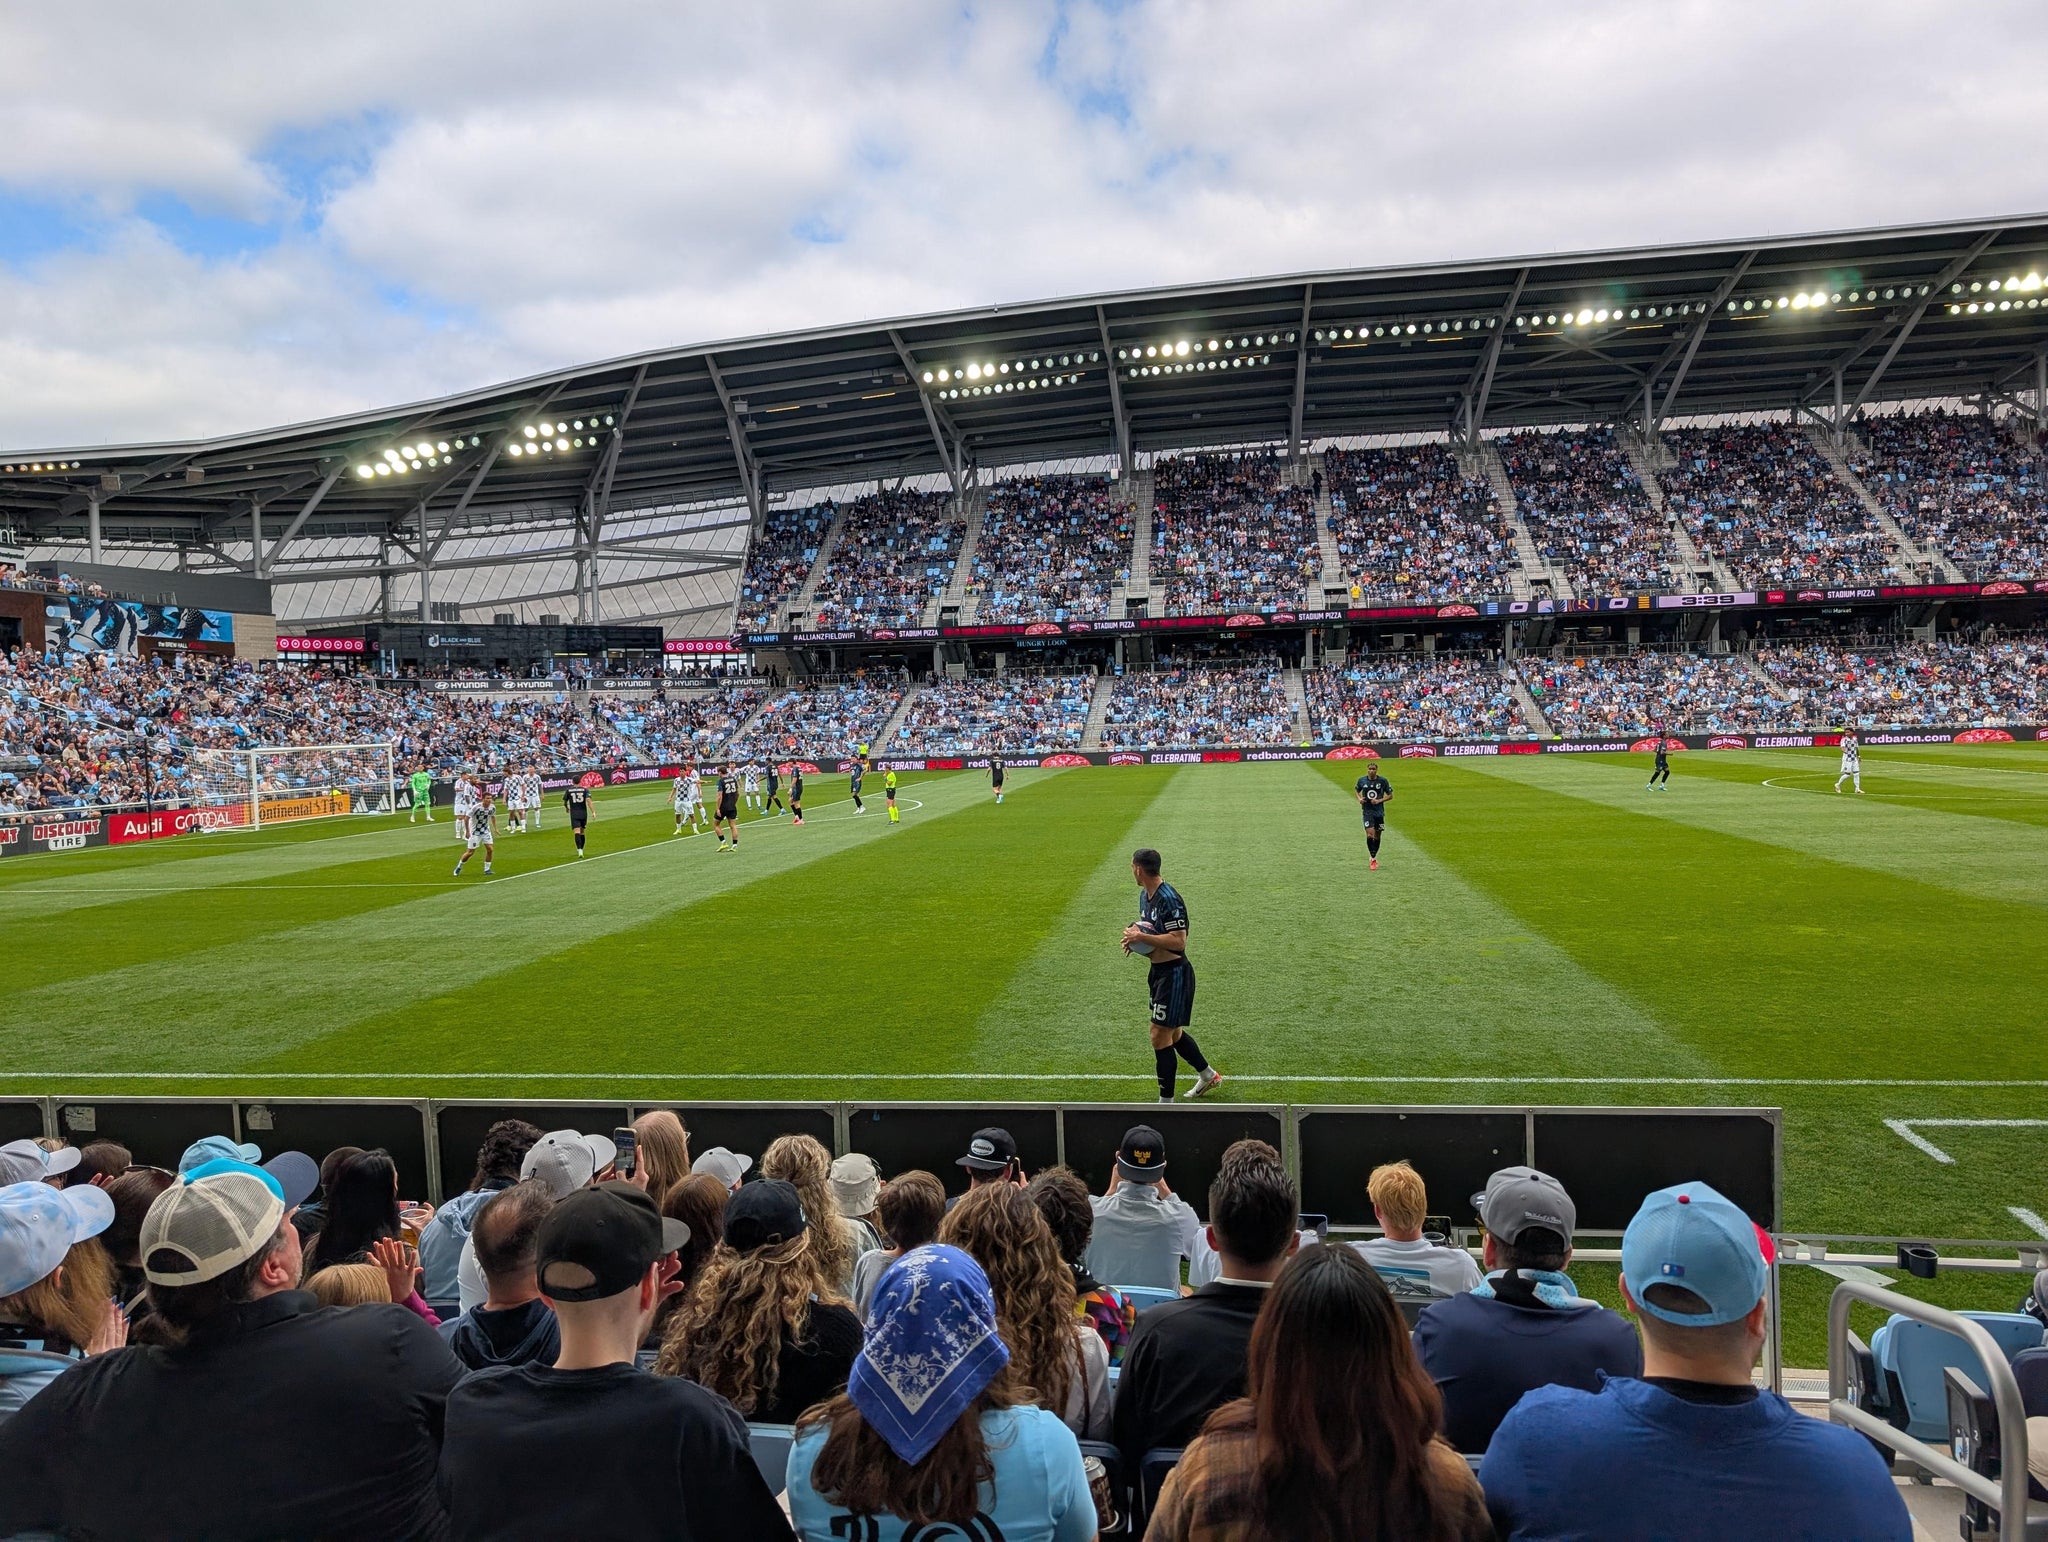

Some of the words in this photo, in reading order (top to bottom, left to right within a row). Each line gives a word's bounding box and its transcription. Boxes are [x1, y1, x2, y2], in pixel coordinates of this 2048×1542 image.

[1827, 590, 1856, 598] STADIUM
[1857, 589, 1875, 597] PIZZA
[1682, 596, 1734, 605] 3:39
[1298, 612, 1324, 621] STADIUM
[1094, 622, 1118, 630] STADIUM
[1119, 621, 1135, 629] PIZZA
[763, 634, 778, 642] WIFI
[793, 632, 856, 641] #ALLIANZFIELDWIFI
[923, 629, 939, 637] PIZZA
[1016, 640, 1045, 648] HUNGRY
[1710, 739, 1722, 748] RED
[1722, 738, 1744, 747] BARON
[1755, 736, 1813, 748] CELEBRATING
[1865, 734, 1951, 744] redbaron.com
[1401, 747, 1413, 756] RED
[1413, 746, 1434, 755] BARON
[1444, 744, 1498, 756] CELEBRATING
[1547, 741, 1628, 752] redbaron.com
[1121, 754, 1141, 763] BARON
[1150, 752, 1201, 764] CELEBRATING
[1247, 750, 1324, 761] redbaron.com
[628, 768, 659, 780] CELEBRATING
[725, 783, 736, 794] 23
[570, 792, 584, 803] 13
[33, 819, 101, 841] DISCOUNT
[124, 818, 163, 836] Audi
[53, 836, 82, 848] TIRE
[1152, 1003, 1167, 1022] 15
